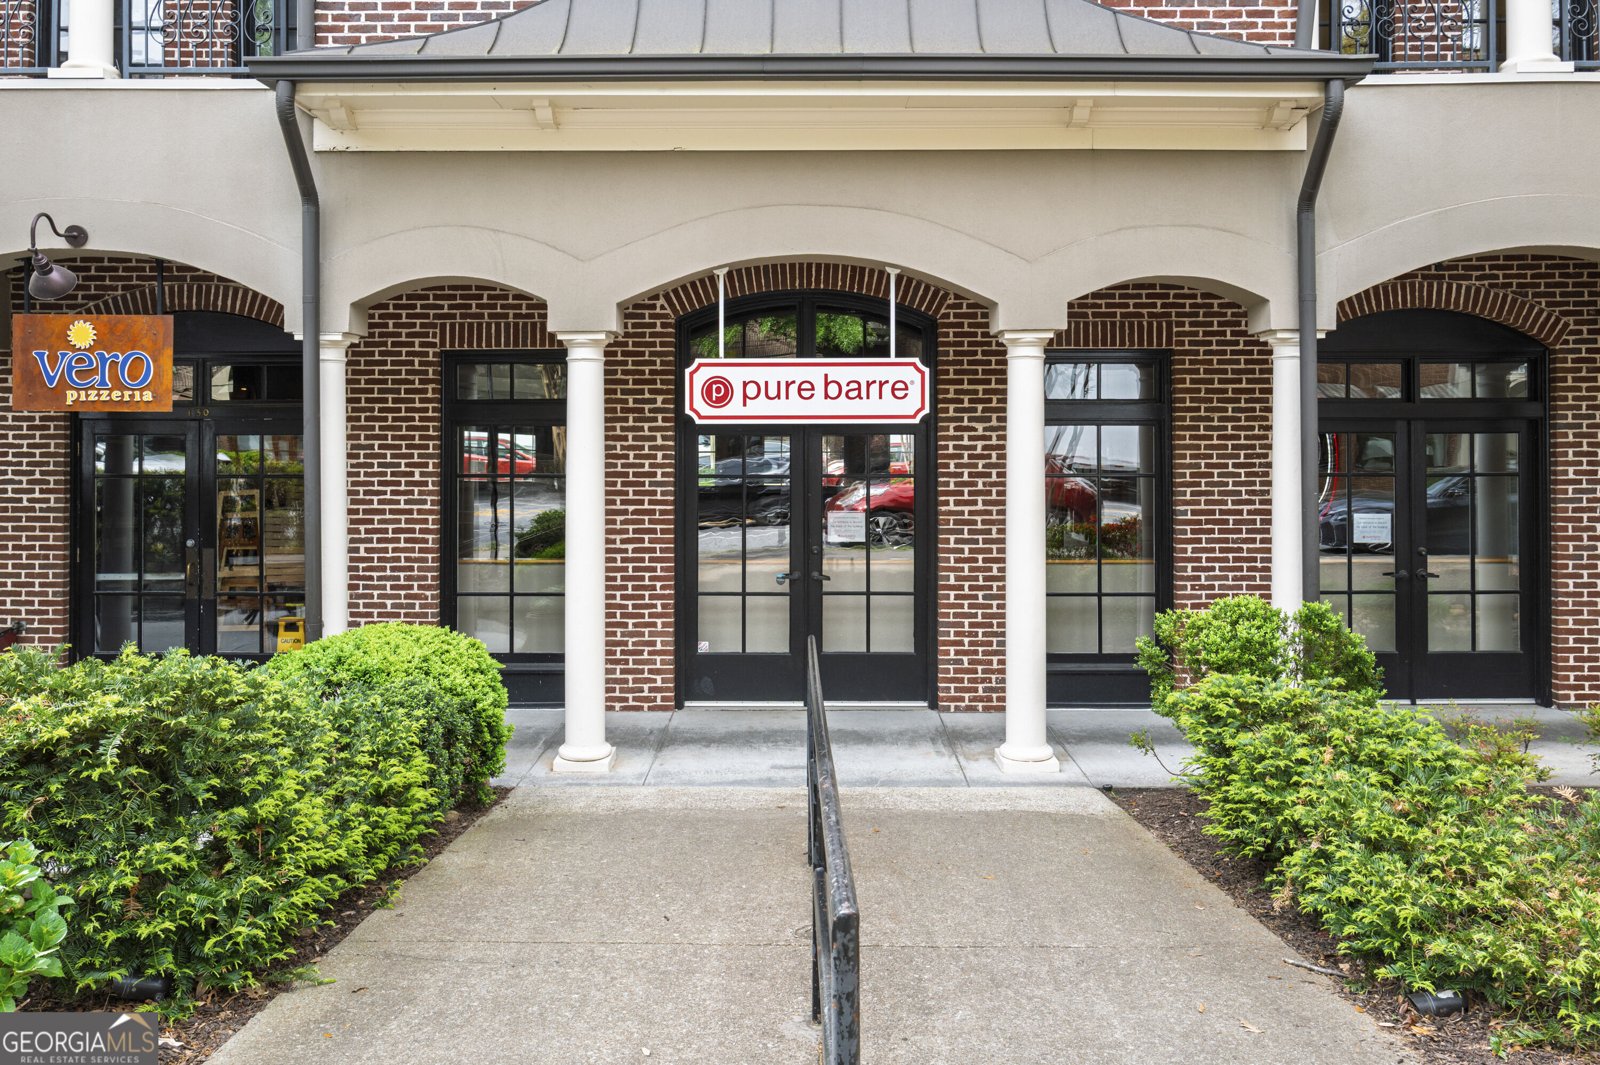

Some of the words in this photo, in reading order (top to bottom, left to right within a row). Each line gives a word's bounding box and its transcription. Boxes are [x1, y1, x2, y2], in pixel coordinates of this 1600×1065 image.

[32, 350, 154, 389] vero
[65, 390, 153, 405] pizzeria
[742, 379, 816, 407] pure
[823, 373, 909, 401] barre
